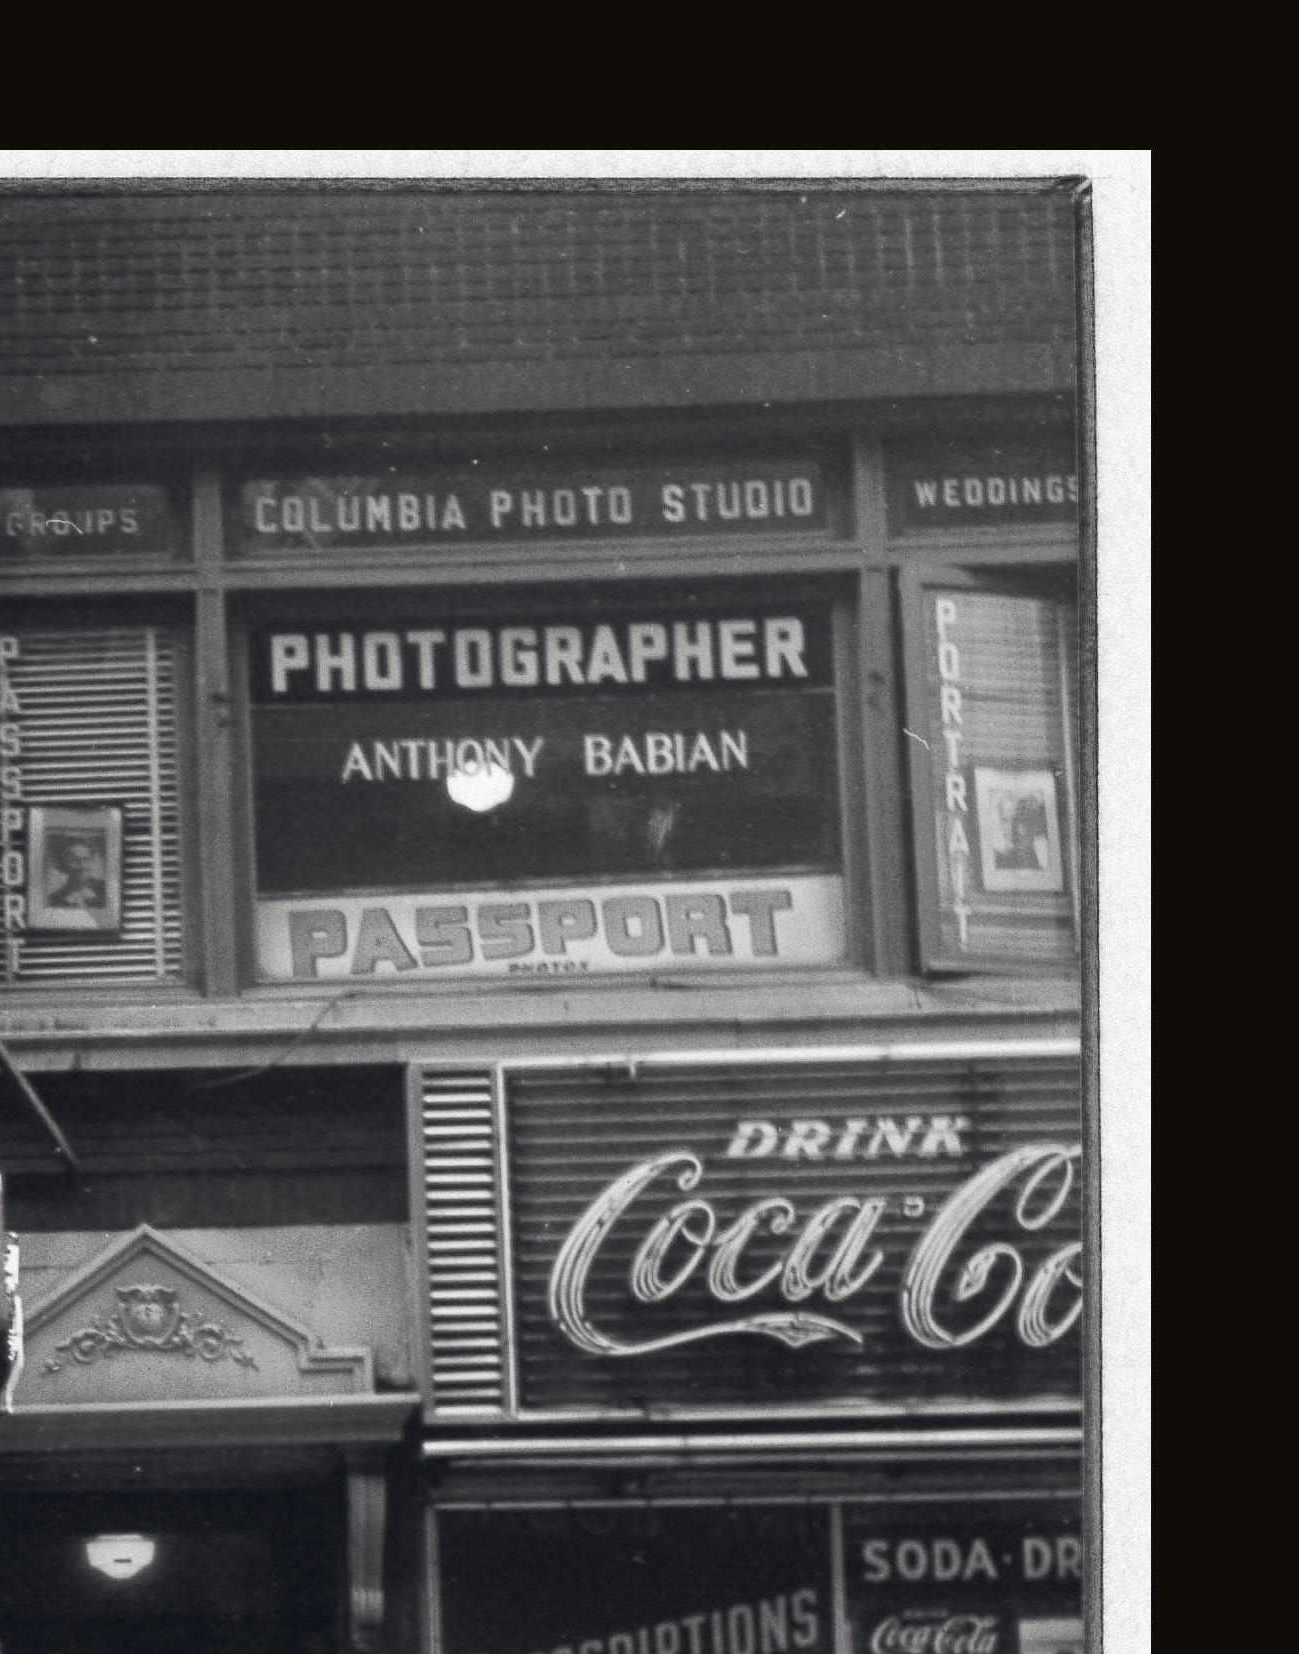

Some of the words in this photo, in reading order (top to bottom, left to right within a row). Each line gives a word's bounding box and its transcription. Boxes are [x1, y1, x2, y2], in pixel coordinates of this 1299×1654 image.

[254, 495, 466, 534] COLUMBIA
[490, 486, 634, 528] PHOTO
[662, 478, 814, 522] STUDIO
[270, 617, 808, 693] PHOTOGRAPHER
[341, 736, 545, 783] ANTHONY
[584, 730, 750, 776] BABIAN
[935, 599, 969, 953] PORTRAIT
[287, 888, 793, 978] PASSPORT
[726, 1115, 971, 1158] DRINK
